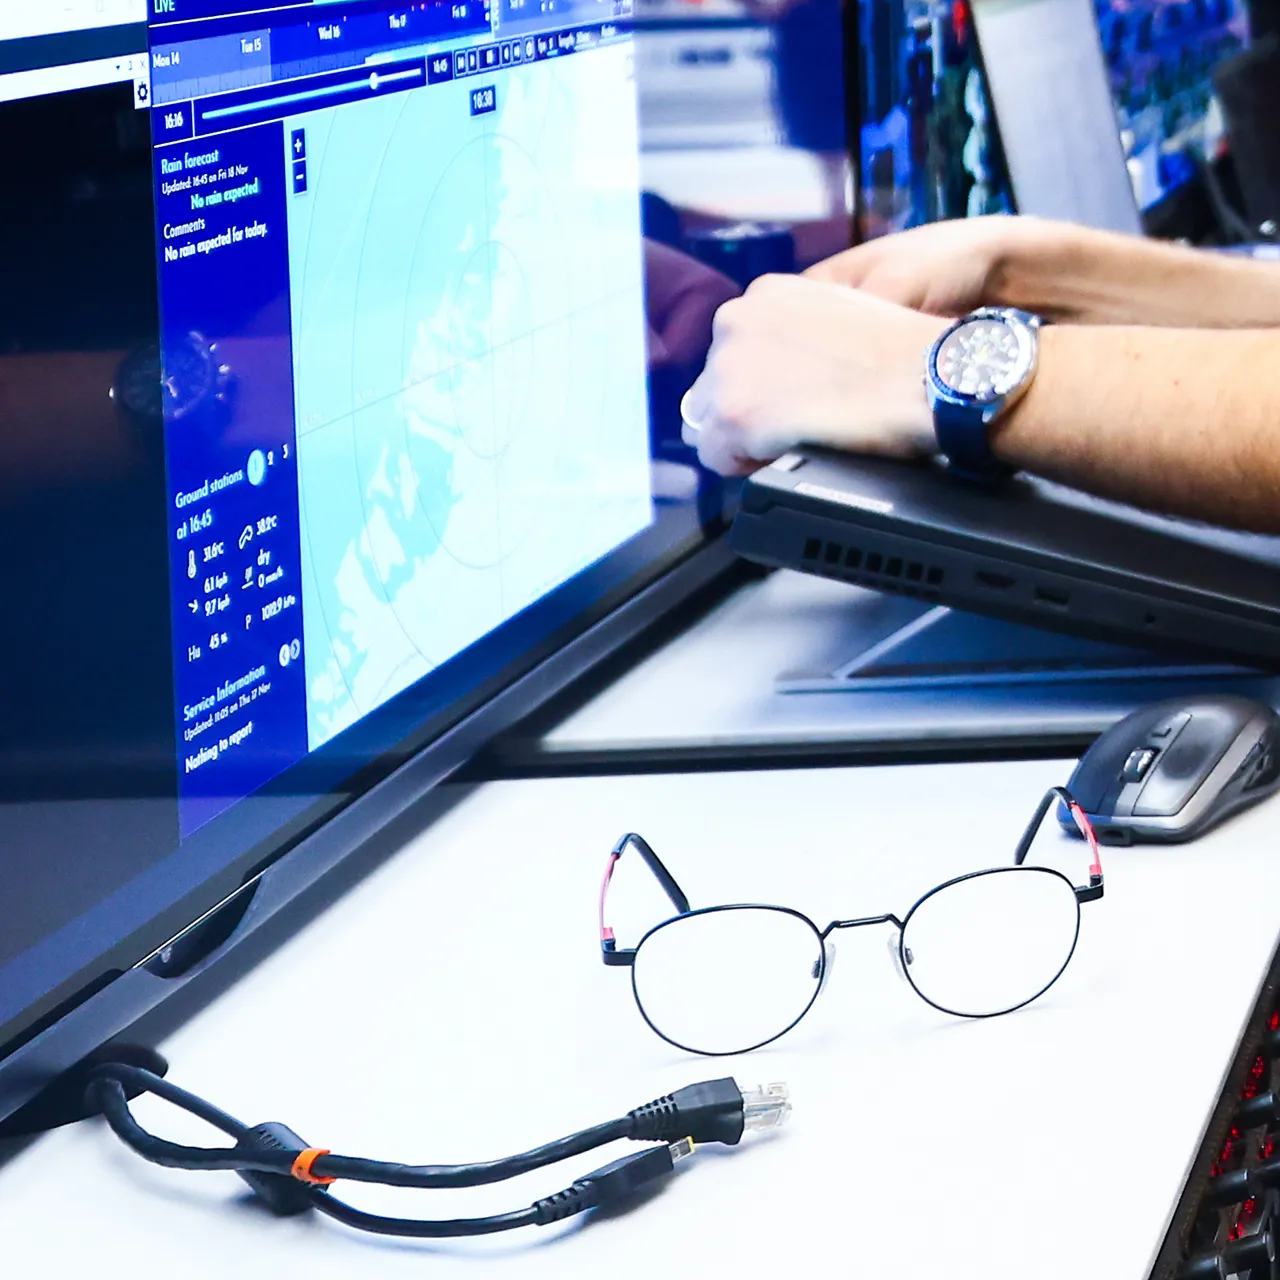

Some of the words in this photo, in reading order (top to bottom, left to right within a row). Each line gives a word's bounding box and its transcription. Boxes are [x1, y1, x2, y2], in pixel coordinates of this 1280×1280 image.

[241, 39, 253, 54] Tue
[253, 38, 262, 51] 15
[318, 25, 333, 40] Wed
[152, 53, 170, 68] Mon
[171, 51, 180, 64] 14
[164, 111, 184, 129] 16:16
[161, 154, 182, 175] Rain
[184, 149, 219, 169] forecast
[162, 180, 191, 196] Updated:
[192, 173, 208, 187] 16:45
[208, 174, 217, 183] on
[218, 168, 227, 181] Fri
[227, 166, 235, 178] 18
[235, 165, 249, 177] Nov
[191, 193, 204, 210] No
[205, 191, 223, 206] rain
[223, 177, 258, 203] expected
[163, 218, 206, 240] Comments
[164, 245, 178, 263] No
[179, 241, 196, 258] rain
[197, 228, 231, 255] expected
[232, 225, 244, 243] for
[244, 220, 268, 244] today.
[175, 479, 209, 509] Ground
[210, 469, 243, 494] stations
[176, 521, 187, 540] at
[189, 508, 212, 534] 16:45
[257, 548, 271, 566] dry
[258, 573, 264, 588] 0
[188, 644, 201, 662] Hu
[209, 632, 220, 651] 45
[183, 695, 215, 722] Service
[216, 665, 265, 702] Information
[184, 713, 213, 742] Updated:
[229, 703, 239, 715] on
[239, 693, 251, 708] Thu
[185, 744, 218, 774] Nothing
[218, 737, 228, 752] to
[228, 721, 253, 746] report
